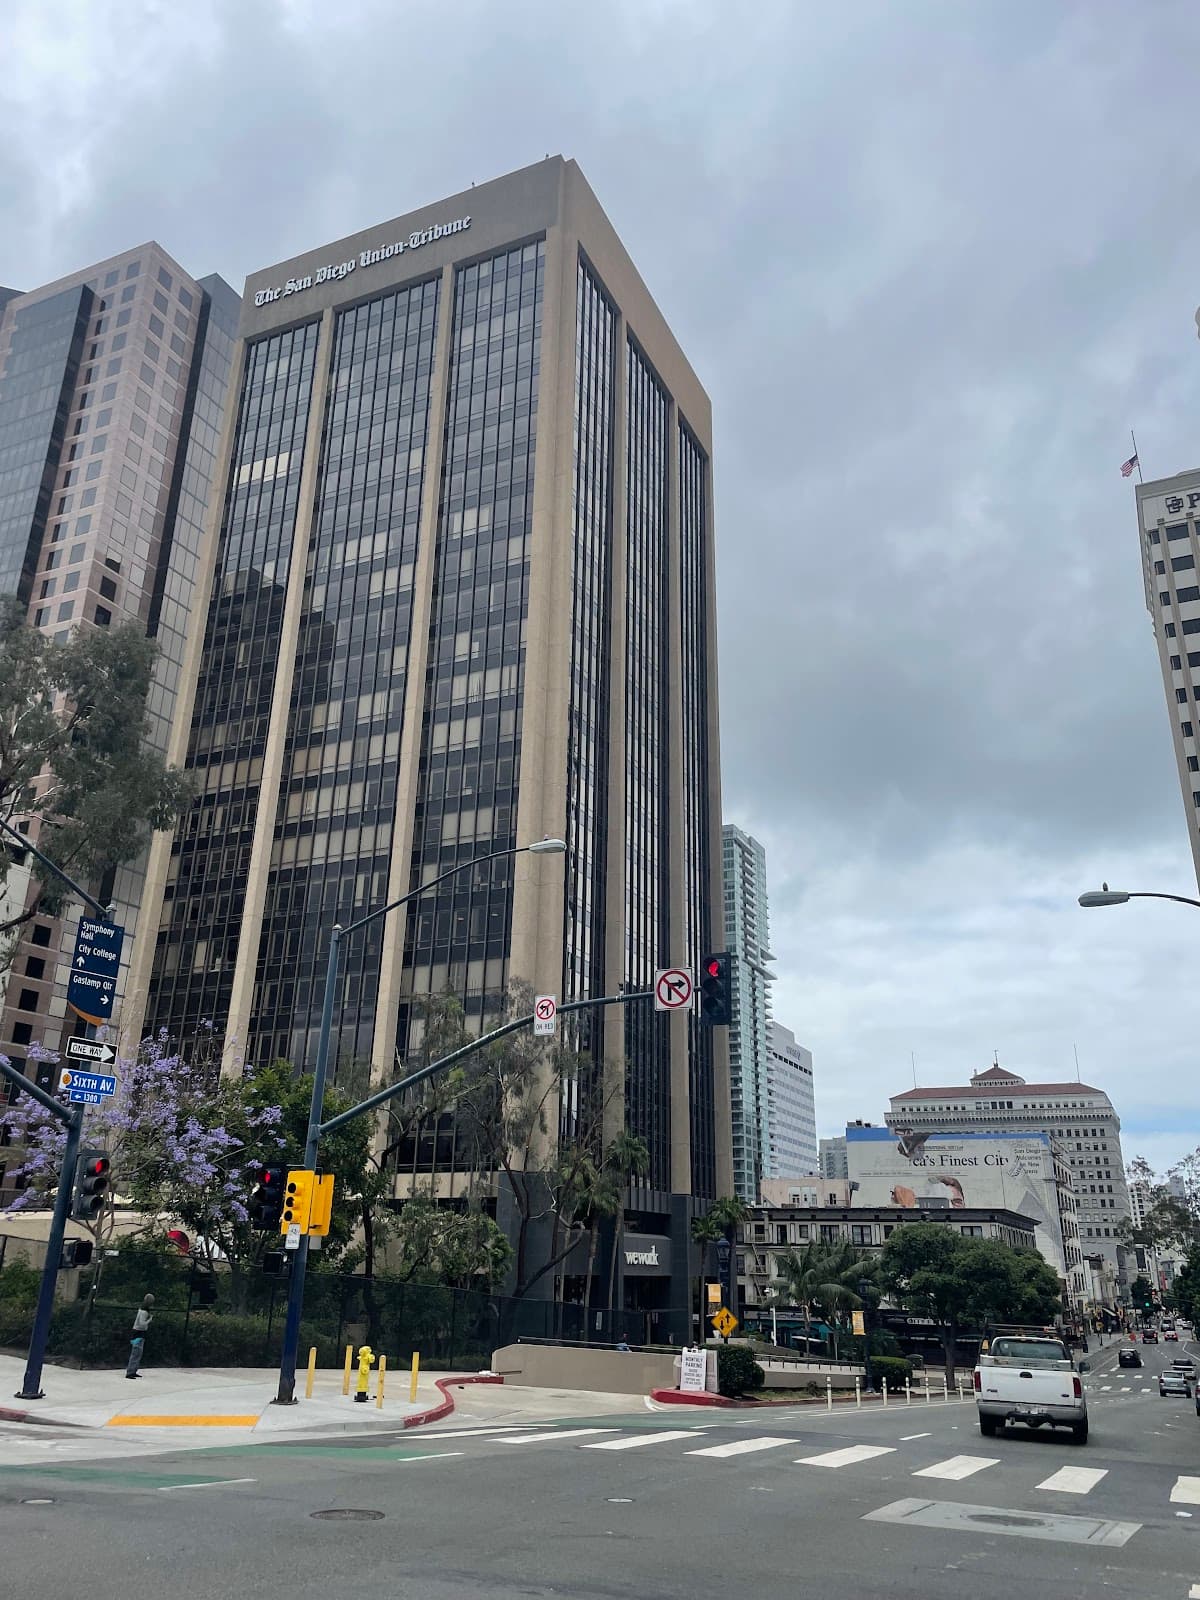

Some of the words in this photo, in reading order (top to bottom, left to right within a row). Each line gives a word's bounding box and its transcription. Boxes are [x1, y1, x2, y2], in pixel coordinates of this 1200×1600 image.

[255, 287, 282, 307] The
[283, 278, 312, 297] San
[314, 264, 356, 286] Diego
[360, 215, 472, 268] Union-Tribune
[80, 930, 94, 941] Hall
[82, 921, 115, 938] Symphony
[78, 944, 92, 956] City
[92, 947, 117, 961] College
[73, 975, 101, 990] Gaslamp
[102, 981, 113, 991] Qtr
[536, 1023, 543, 1031] ON
[544, 1022, 553, 1030] RED
[72, 1044, 87, 1054] ONE
[89, 1047, 103, 1057] WAY
[72, 1074, 98, 1090] SIXTH
[99, 1078, 113, 1092] AV.
[83, 1093, 98, 1103] 1300
[939, 1154, 979, 1167] Finest
